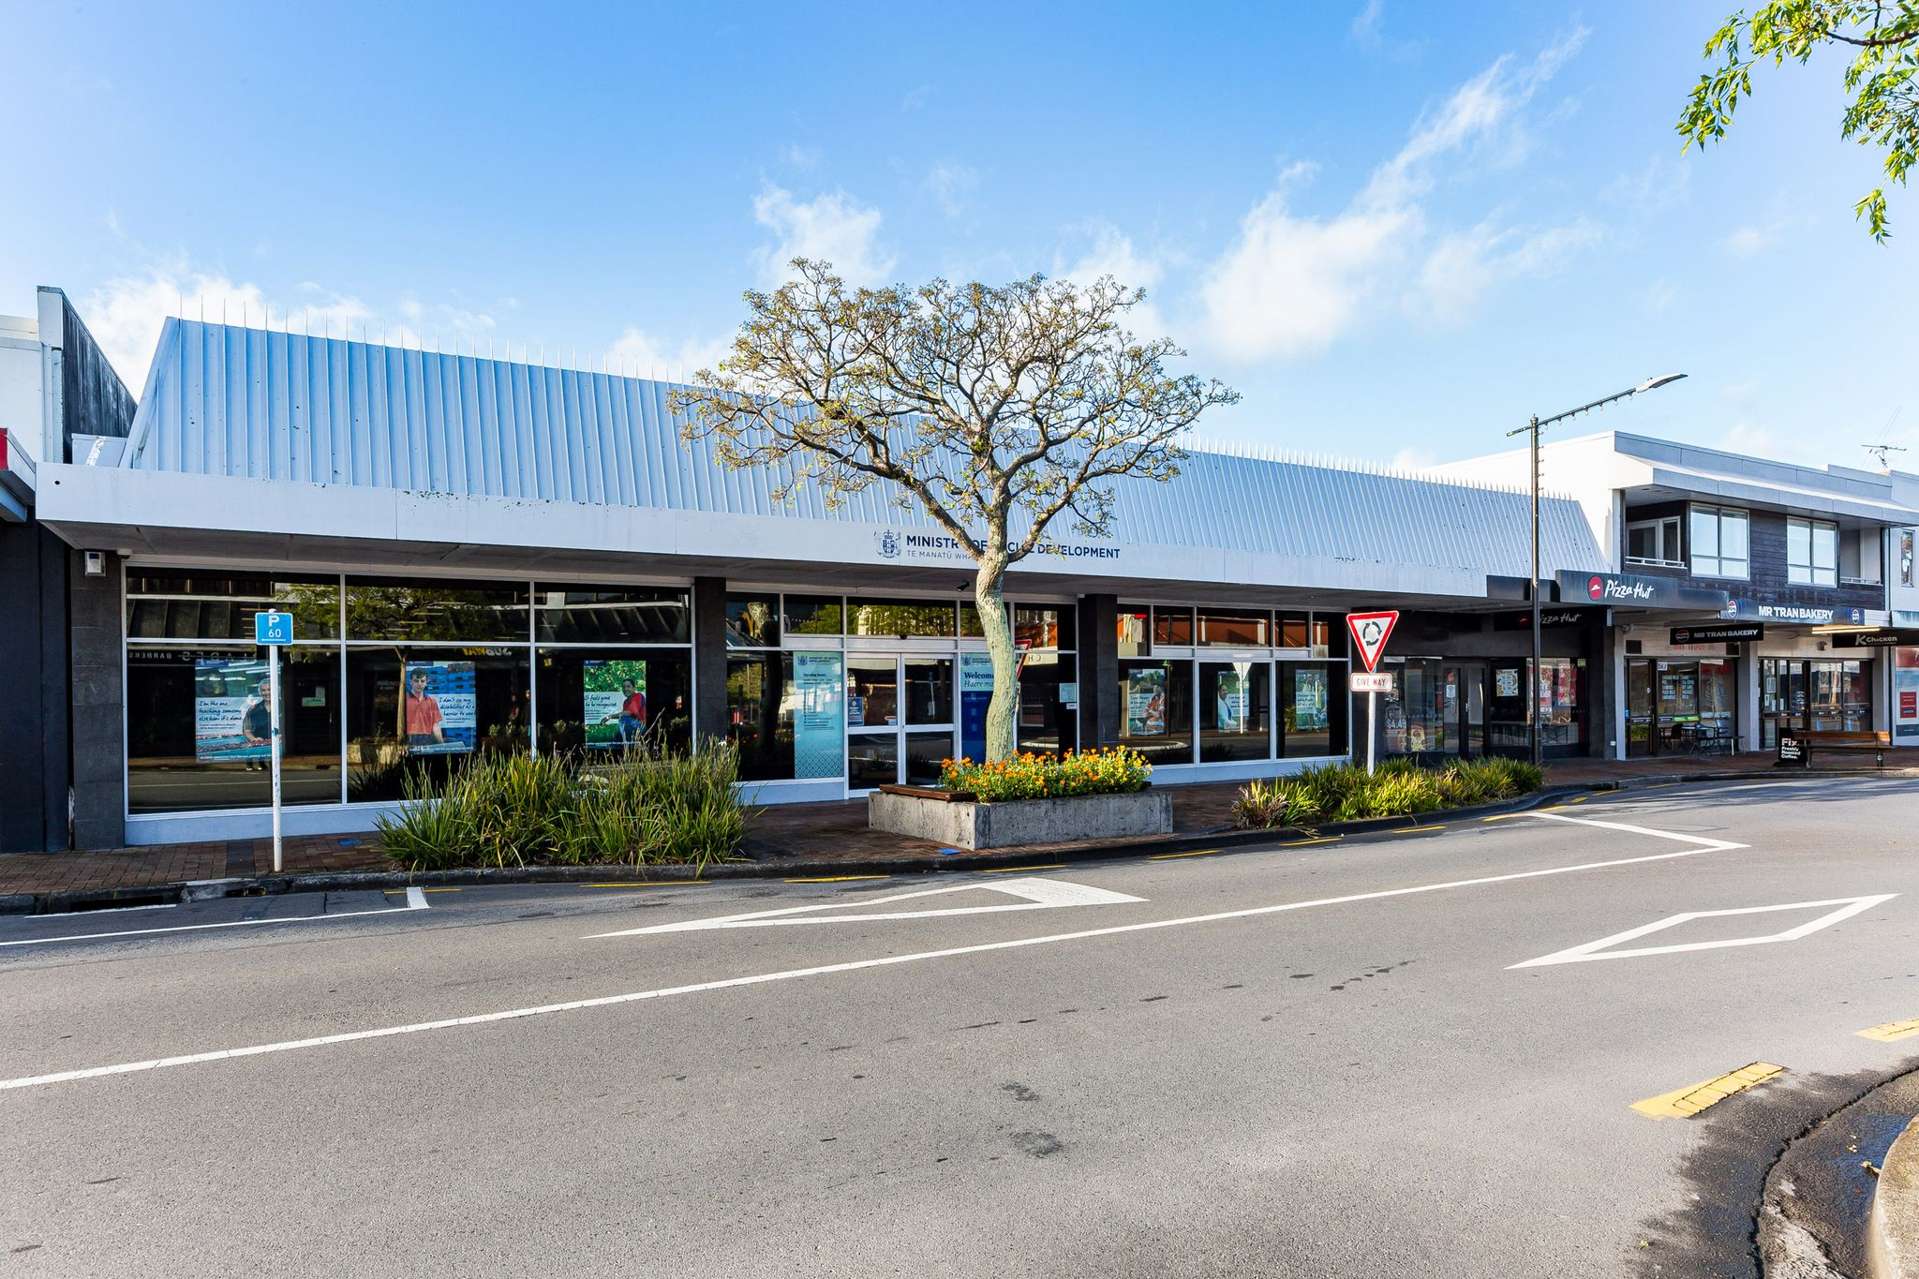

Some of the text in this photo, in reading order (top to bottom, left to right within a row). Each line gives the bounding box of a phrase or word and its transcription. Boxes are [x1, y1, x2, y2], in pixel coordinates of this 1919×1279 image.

[906, 535, 960, 549] MINISTR
[1038, 544, 1121, 558] DEVELOPMENT
[1604, 579, 1655, 599] Pizza Hut
[1758, 605, 1834, 620] MR TRAN BAKERY
[268, 615, 280, 627] P
[1541, 613, 1582, 624] izza Hut
[268, 628, 281, 638] 60
[1727, 629, 1759, 637] BAKERY
[1372, 677, 1386, 687] WAY
